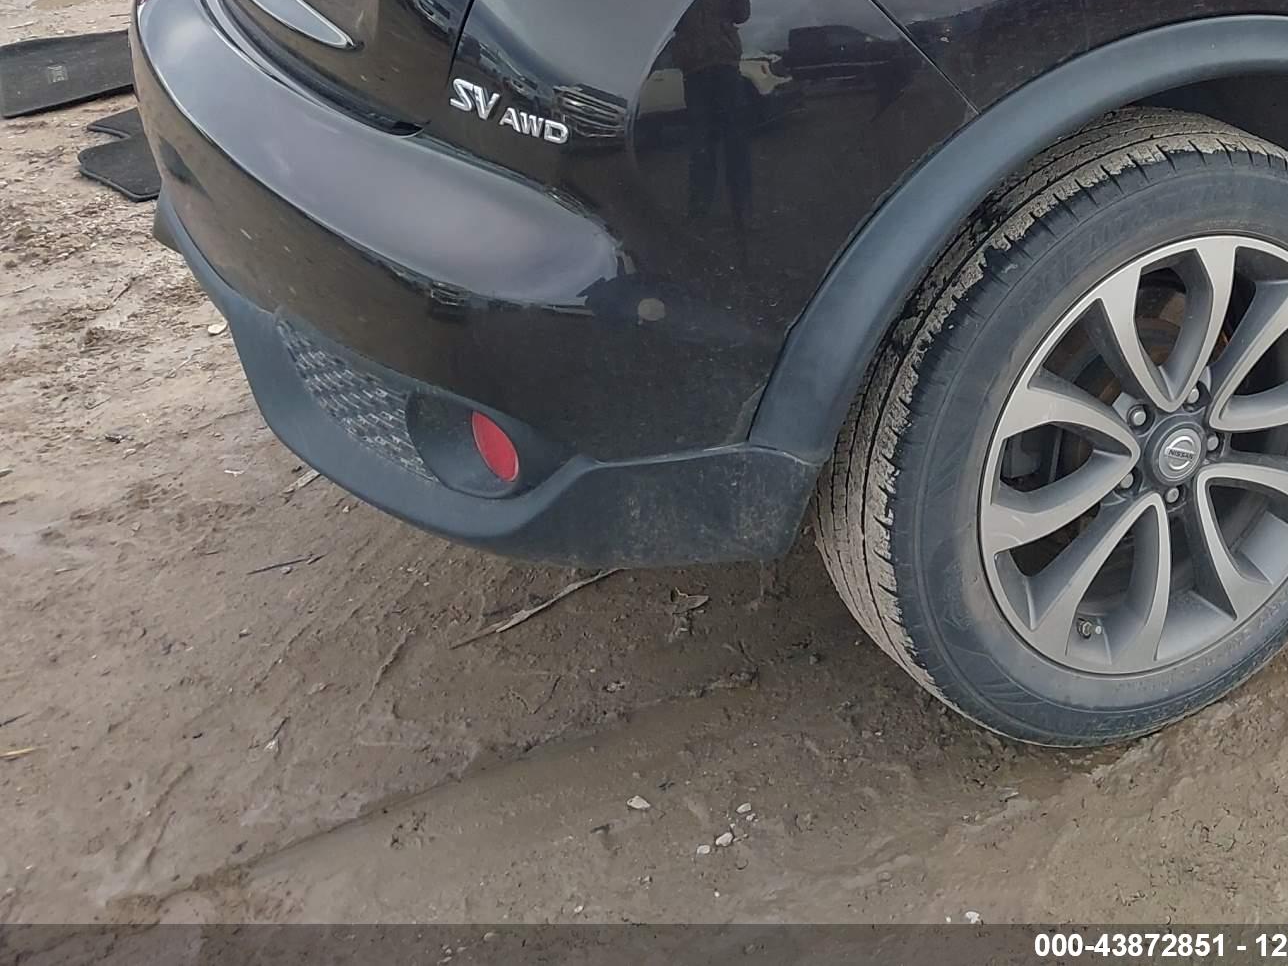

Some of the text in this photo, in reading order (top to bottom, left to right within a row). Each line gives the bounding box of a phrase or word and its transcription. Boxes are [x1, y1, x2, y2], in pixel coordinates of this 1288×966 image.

[449, 78, 569, 144] SV AWD
[1168, 449, 1194, 460] NISSAN
